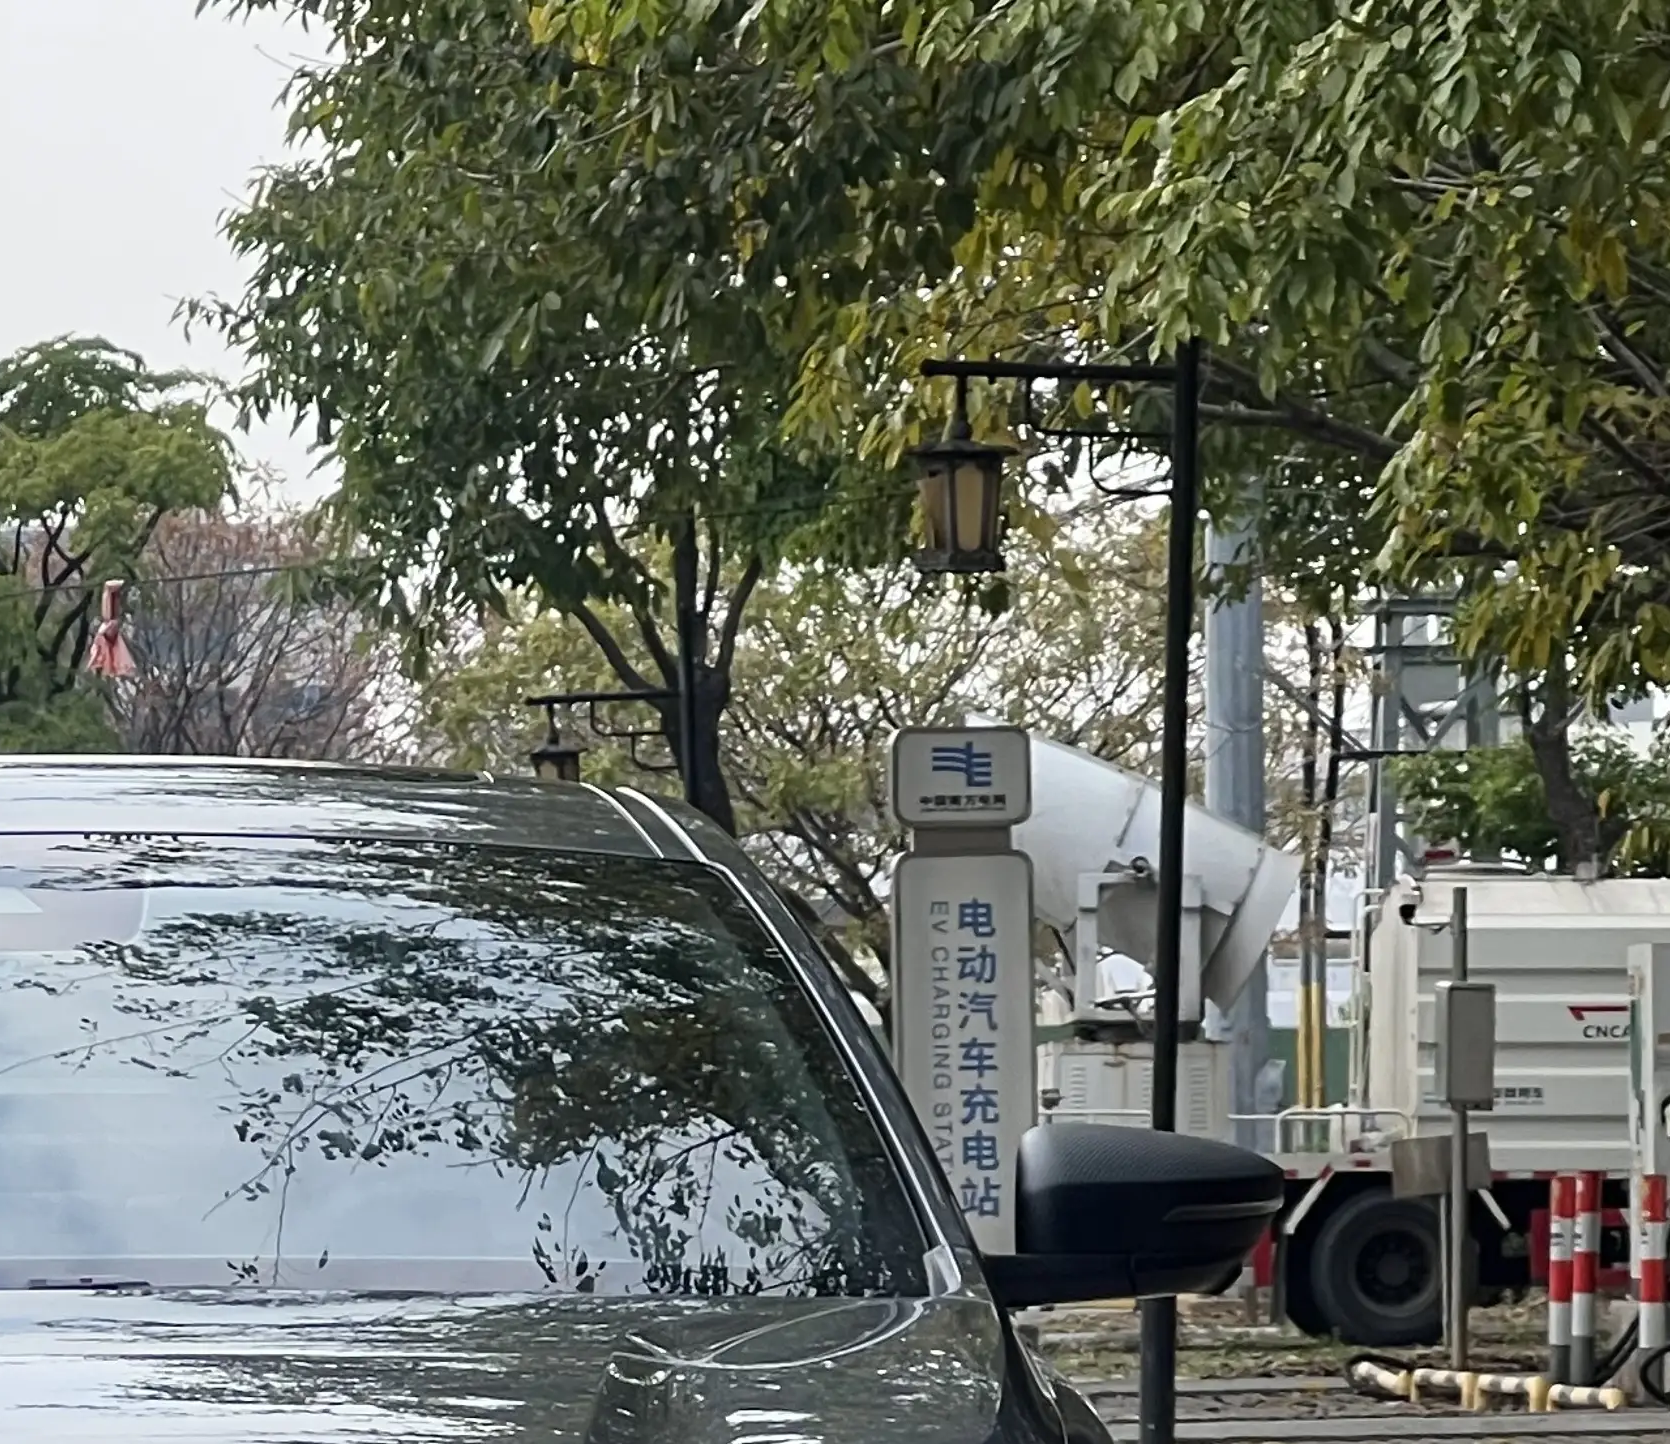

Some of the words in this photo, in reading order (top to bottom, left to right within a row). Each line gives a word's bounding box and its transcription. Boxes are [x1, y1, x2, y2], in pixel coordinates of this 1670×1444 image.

[930, 901, 950, 934] EV
[931, 946, 952, 1090] CHARGING
[957, 897, 1002, 1218] 电动汽车充电站
[933, 1102, 955, 1175] STAT
